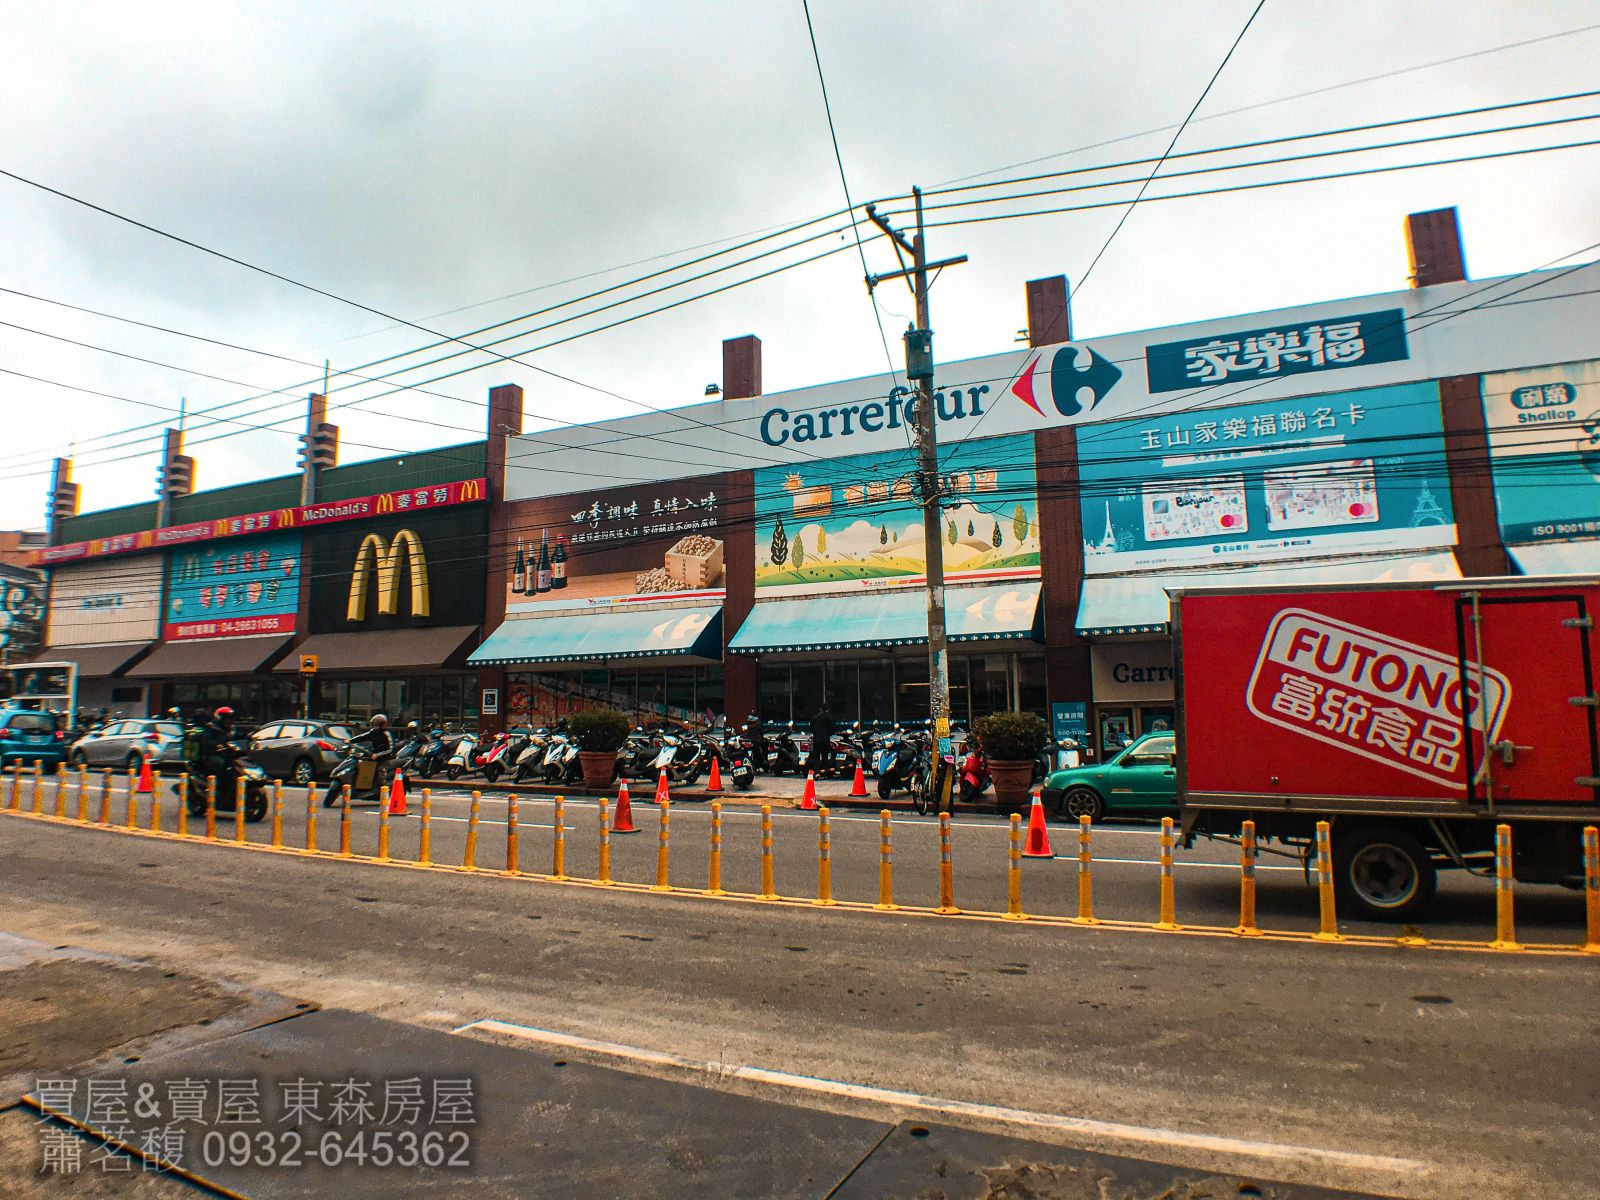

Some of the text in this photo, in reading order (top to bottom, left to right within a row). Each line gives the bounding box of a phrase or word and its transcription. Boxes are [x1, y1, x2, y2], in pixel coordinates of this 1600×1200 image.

[1184, 321, 1366, 383] 家樂福
[1140, 402, 1367, 451] 玉山家樂福聯名卡
[1517, 409, 1577, 424] Shallop
[397, 488, 448, 508] 麥當勞
[651, 491, 718, 517] 真情入味
[1175, 494, 1215, 509] Bonjour
[302, 502, 369, 522] McDonald's
[1533, 525, 1554, 536] ISO
[1287, 626, 1482, 718] FUTONG
[1271, 672, 1462, 774] 富統食品
